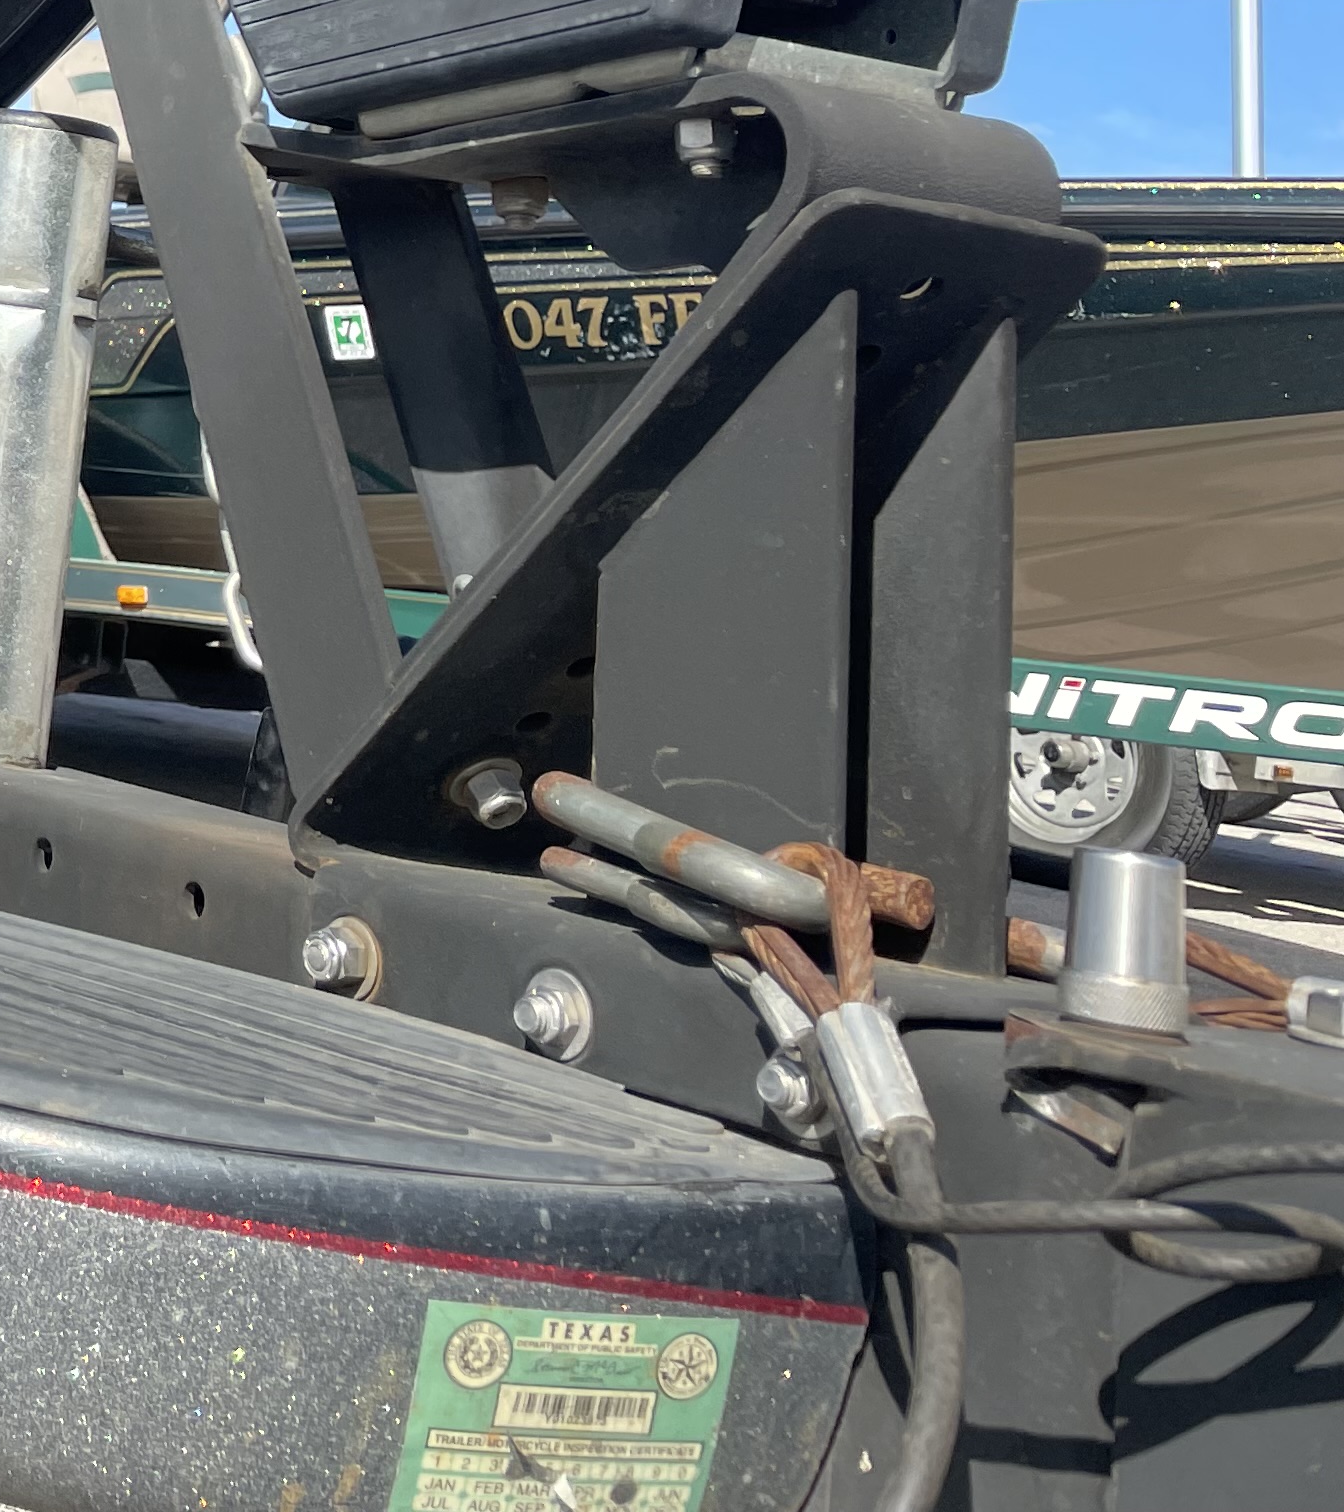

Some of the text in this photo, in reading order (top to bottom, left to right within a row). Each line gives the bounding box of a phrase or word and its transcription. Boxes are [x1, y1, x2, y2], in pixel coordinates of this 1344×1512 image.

[549, 1321, 631, 1342] TEXAS
[516, 1339, 658, 1357] DEPARTMENT OF PUBLIC SAFETY
[462, 1457, 471, 1471] 2
[424, 1477, 457, 1493] JAN
[473, 1480, 505, 1494] FEB
[421, 1495, 451, 1511] JUL
[466, 1500, 502, 1512] AUG
